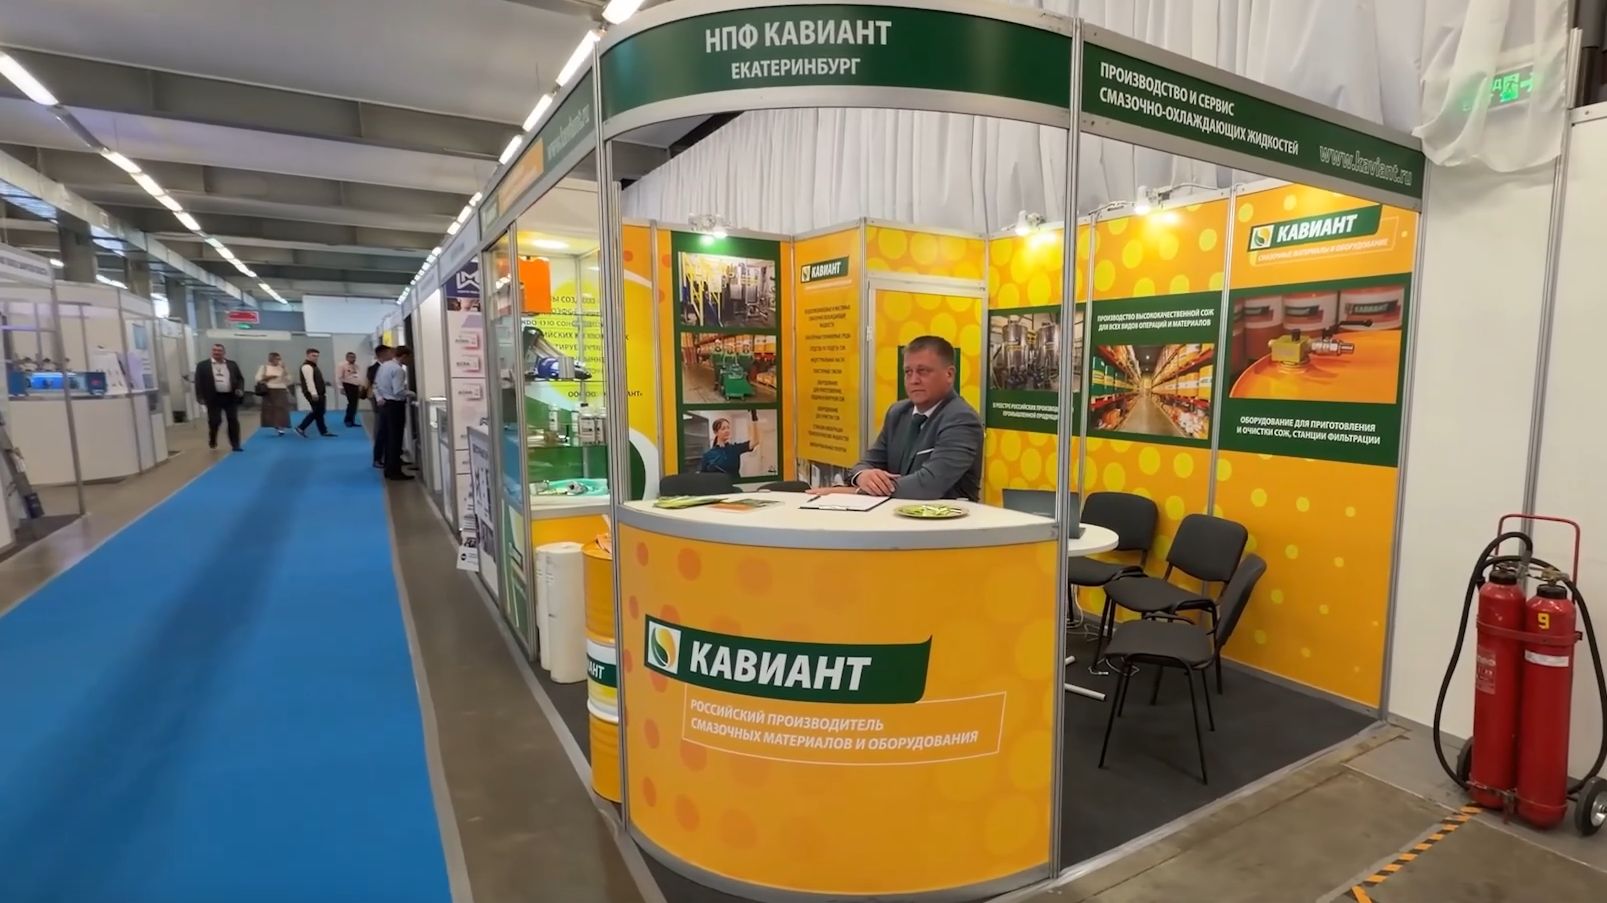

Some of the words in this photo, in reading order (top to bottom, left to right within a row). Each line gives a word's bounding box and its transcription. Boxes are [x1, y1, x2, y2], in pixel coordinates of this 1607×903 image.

[705, 23, 758, 53] НПФ
[764, 19, 892, 46] КАВИАНТ
[731, 58, 861, 79] ЕКАТЕРИНБУРГ
[1100, 62, 1188, 102] ПРОИЗВОДСТВО
[1189, 90, 1198, 105] И
[1198, 94, 1235, 116] СЕРВИС
[1099, 86, 1247, 141] СМАЗОЧНО-ОХЛАЖДАЮЩИХ
[1247, 129, 1299, 155] ЖИДКОСТЕЙ
[1319, 145, 1413, 186] www.kaviant.ru
[1276, 213, 1359, 243] КАВИАНТ
[811, 261, 841, 278] КАВИАНТ
[1097, 313, 1135, 322] ПРОИЗВОДСТВО
[1136, 308, 1200, 320] ВЫСОКОКАЧЕСТВЕННОЙ
[1200, 308, 1215, 317] СОЖ
[1098, 323, 1109, 332] ДЛЯ
[1173, 318, 1211, 327] МАТЕРИАЛОВ
[1240, 416, 1293, 428] ОБОРУДОВАНИЕ
[1294, 418, 1310, 429] ДЛЯ
[1310, 420, 1376, 433] ПРИГОТОВЛЕНИЯ
[1242, 427, 1274, 436] ОЧИСТКИ
[1274, 428, 1292, 438] СОЖ,
[1292, 431, 1327, 441] СТАНЦИИ
[1327, 432, 1381, 445] ФИЛЬТРАЦИИ
[1537, 612, 1550, 630] 9
[690, 640, 872, 691] КАВИАНТ
[690, 699, 765, 724] РОССИЙСКИЙ
[767, 713, 884, 731] ПРОИЗВОДИТЕЛЬ
[690, 718, 761, 744] СМАЗОЧНЫХ
[763, 731, 852, 750] МАТЕРИАЛОВ
[855, 738, 865, 750] И
[868, 730, 979, 751] ОБОРУДОВАНИЯ
